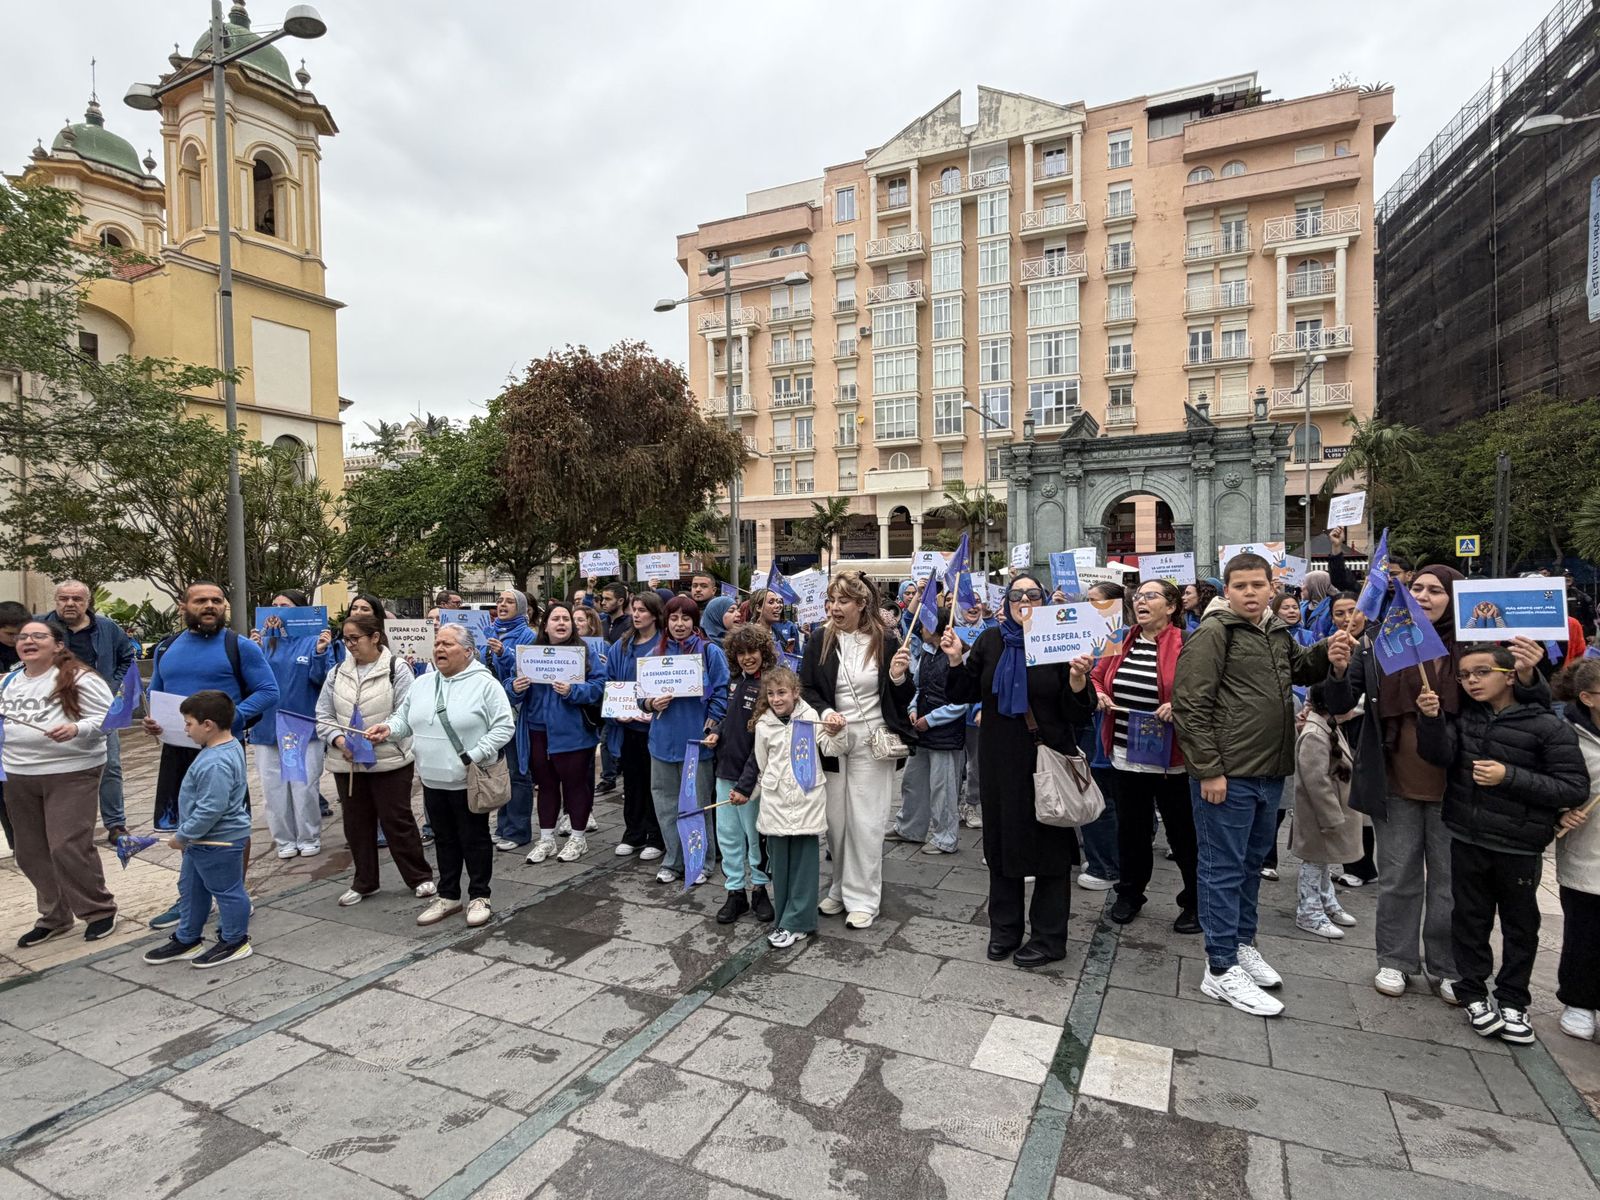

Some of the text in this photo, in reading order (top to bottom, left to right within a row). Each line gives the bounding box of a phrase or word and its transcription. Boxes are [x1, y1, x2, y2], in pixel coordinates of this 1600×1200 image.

[1592, 211, 1600, 297] ESTRUCTURAS
[1042, 634, 1052, 642] ES
[1052, 632, 1082, 641] ESPERA,
[1044, 643, 1080, 654] ABANDONO
